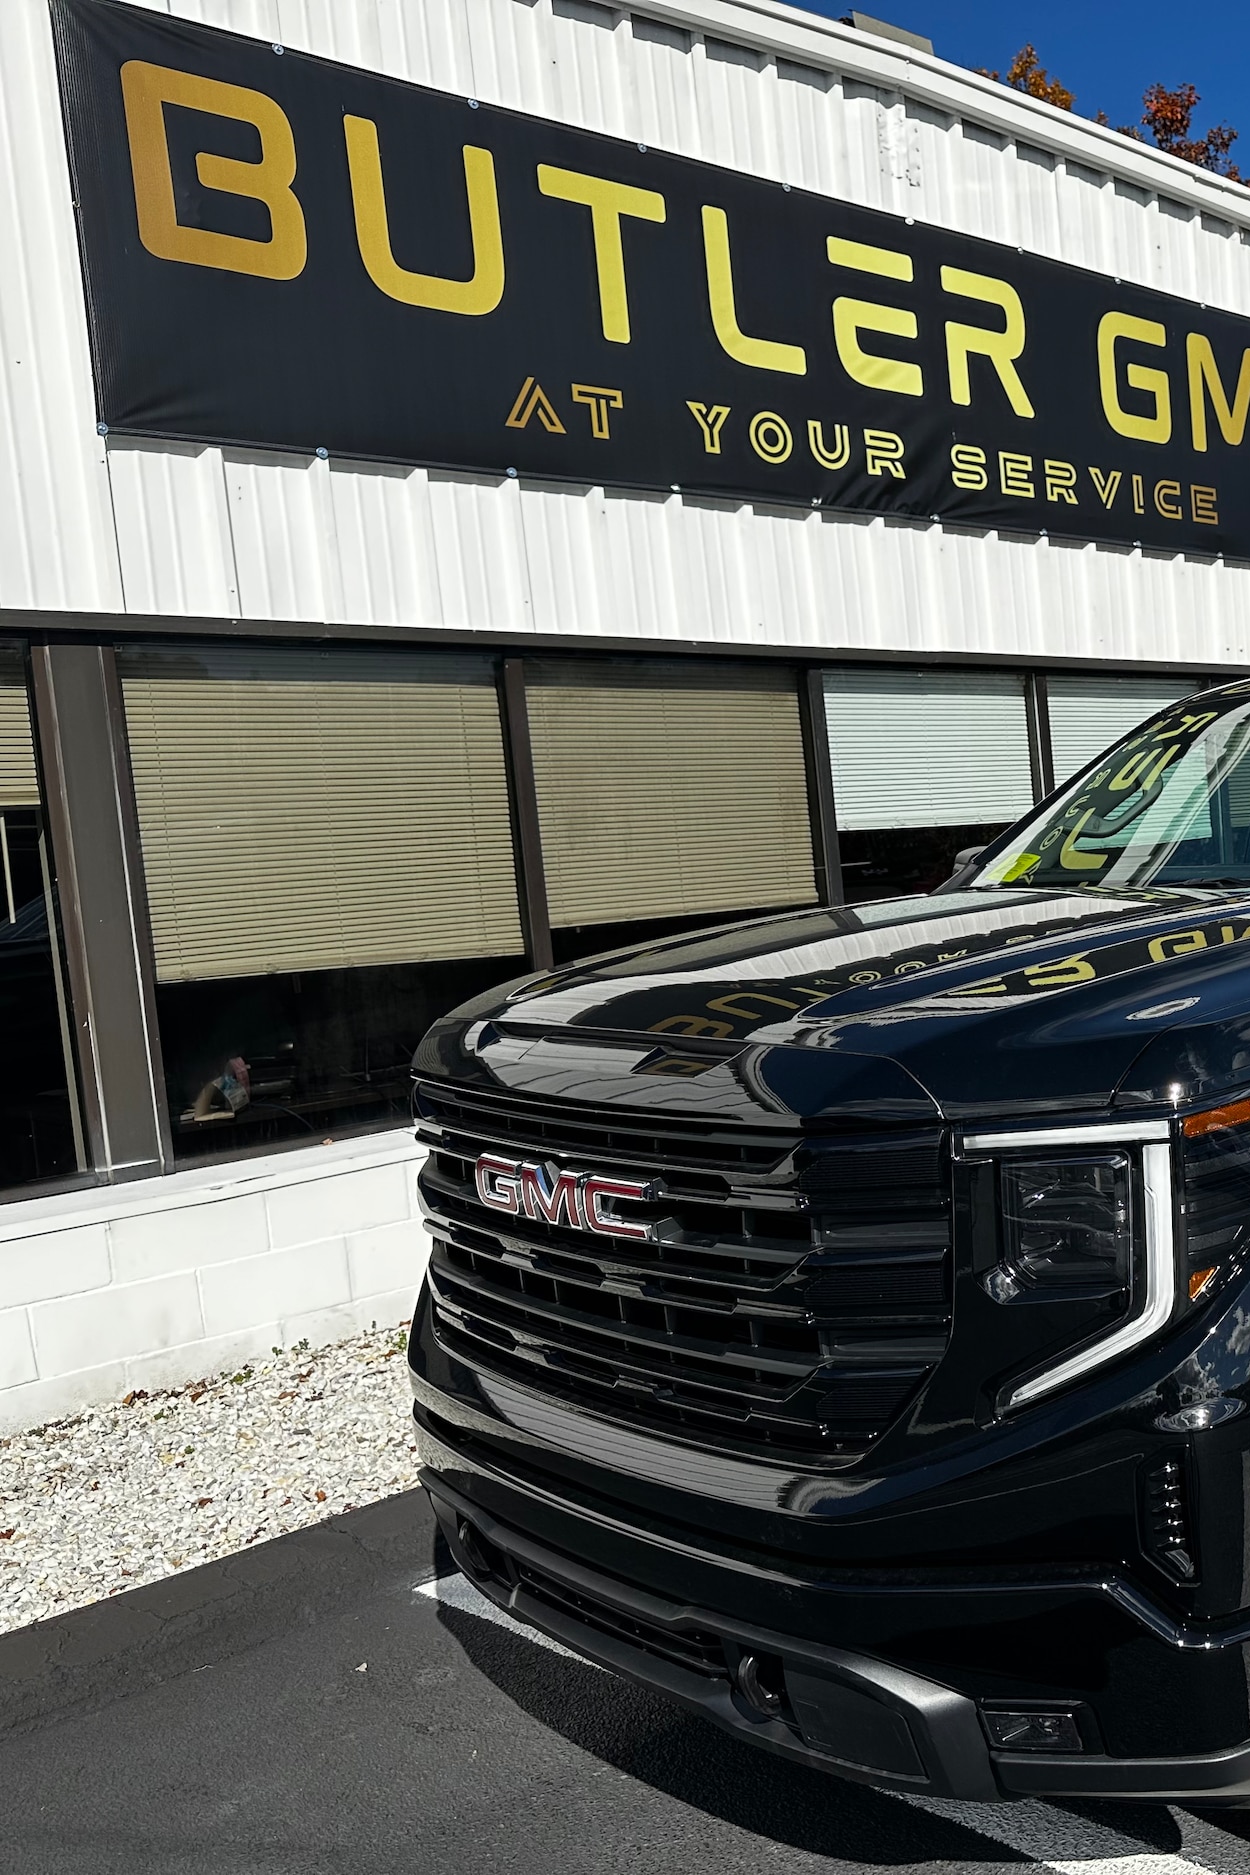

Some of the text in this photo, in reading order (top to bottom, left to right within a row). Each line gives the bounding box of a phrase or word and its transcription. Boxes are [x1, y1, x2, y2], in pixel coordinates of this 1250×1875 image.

[120, 59, 1034, 418] BUTLER
[506, 376, 1218, 525] AT YOUR SERVICE
[474, 1152, 652, 1242] GMC
